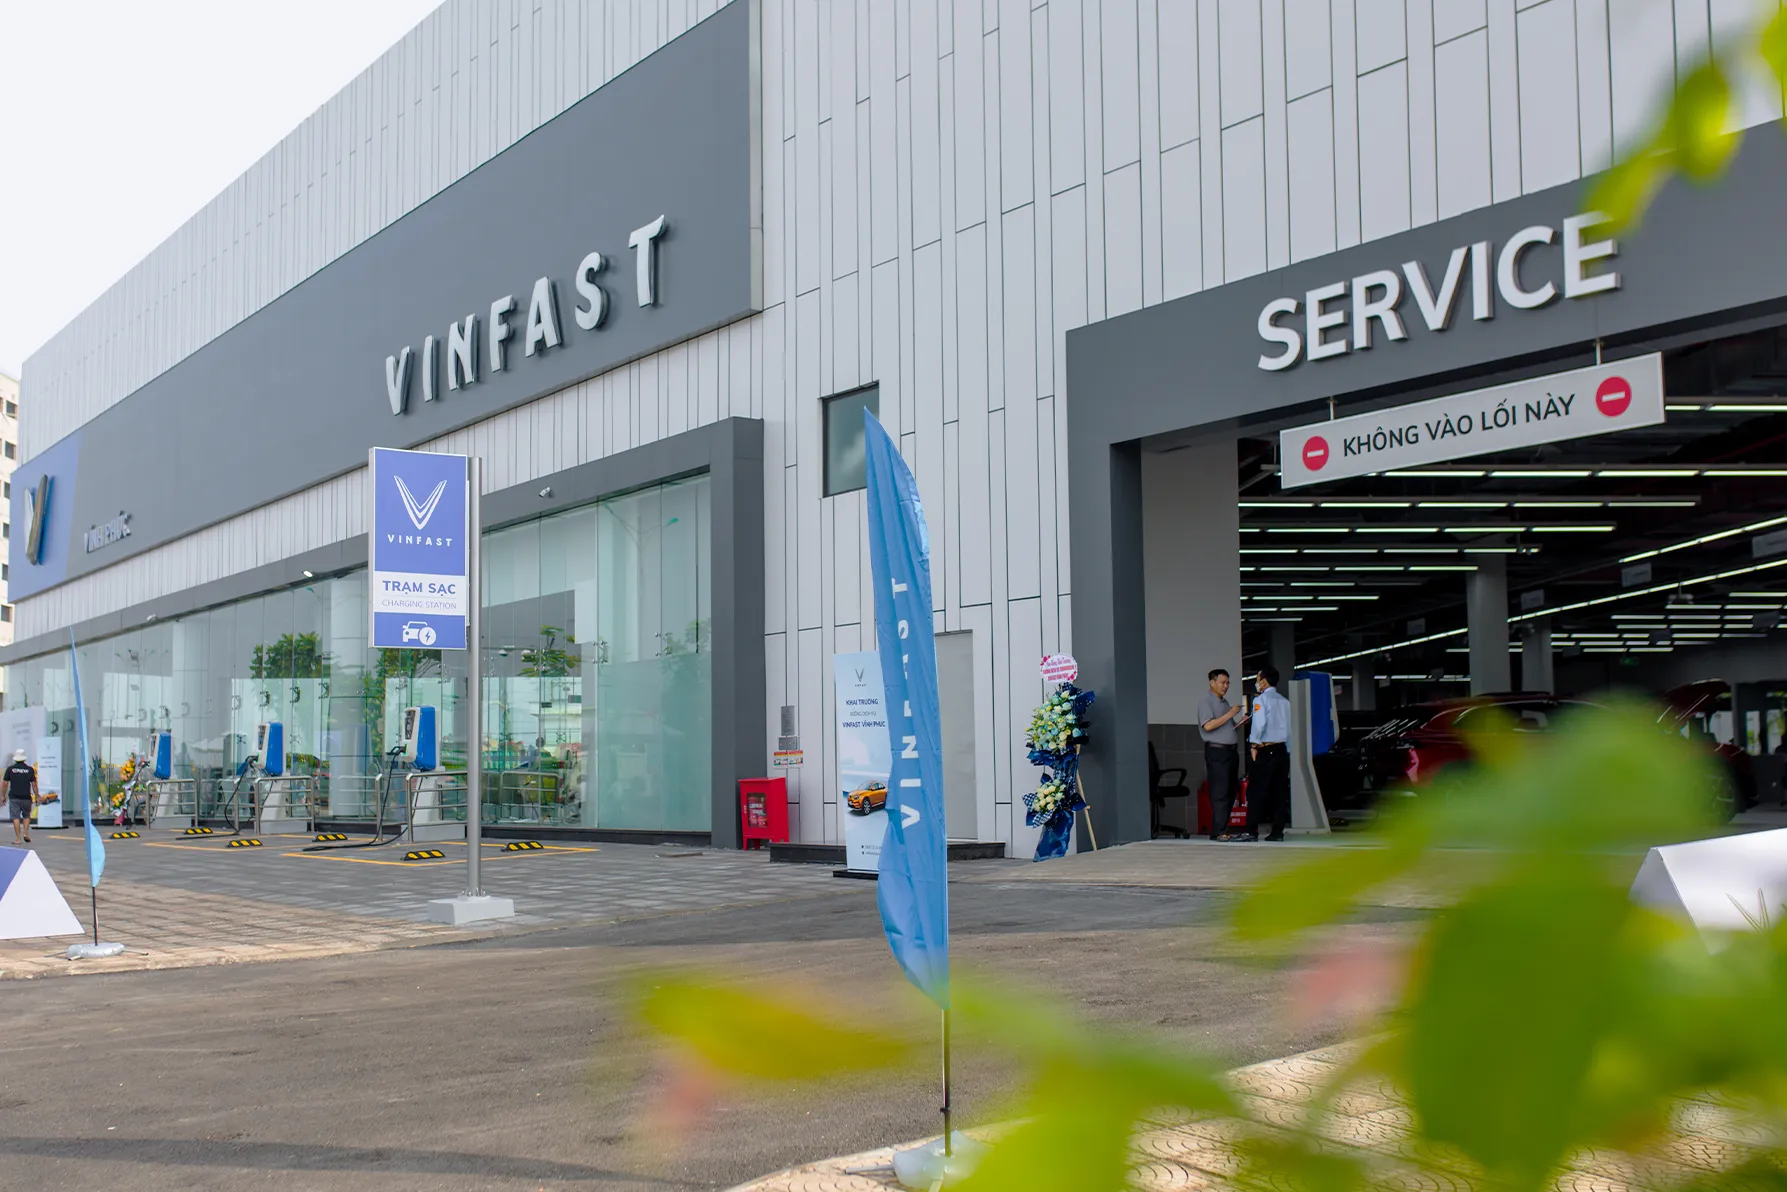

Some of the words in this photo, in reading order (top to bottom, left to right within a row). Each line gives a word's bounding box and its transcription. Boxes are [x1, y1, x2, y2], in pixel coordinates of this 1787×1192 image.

[1257, 210, 1621, 372] SERVICE
[385, 214, 666, 416] VINFAST
[1342, 426, 1420, 457] KHÔNG
[1425, 413, 1473, 441] VÀO
[1481, 398, 1518, 432] LỐI
[1525, 393, 1577, 423] NÀY
[387, 534, 453, 547] VINFAST
[382, 580, 423, 595] TRẠM
[428, 582, 456, 597] SẠC
[382, 599, 423, 609] CHARGING
[425, 601, 457, 610] STATION
